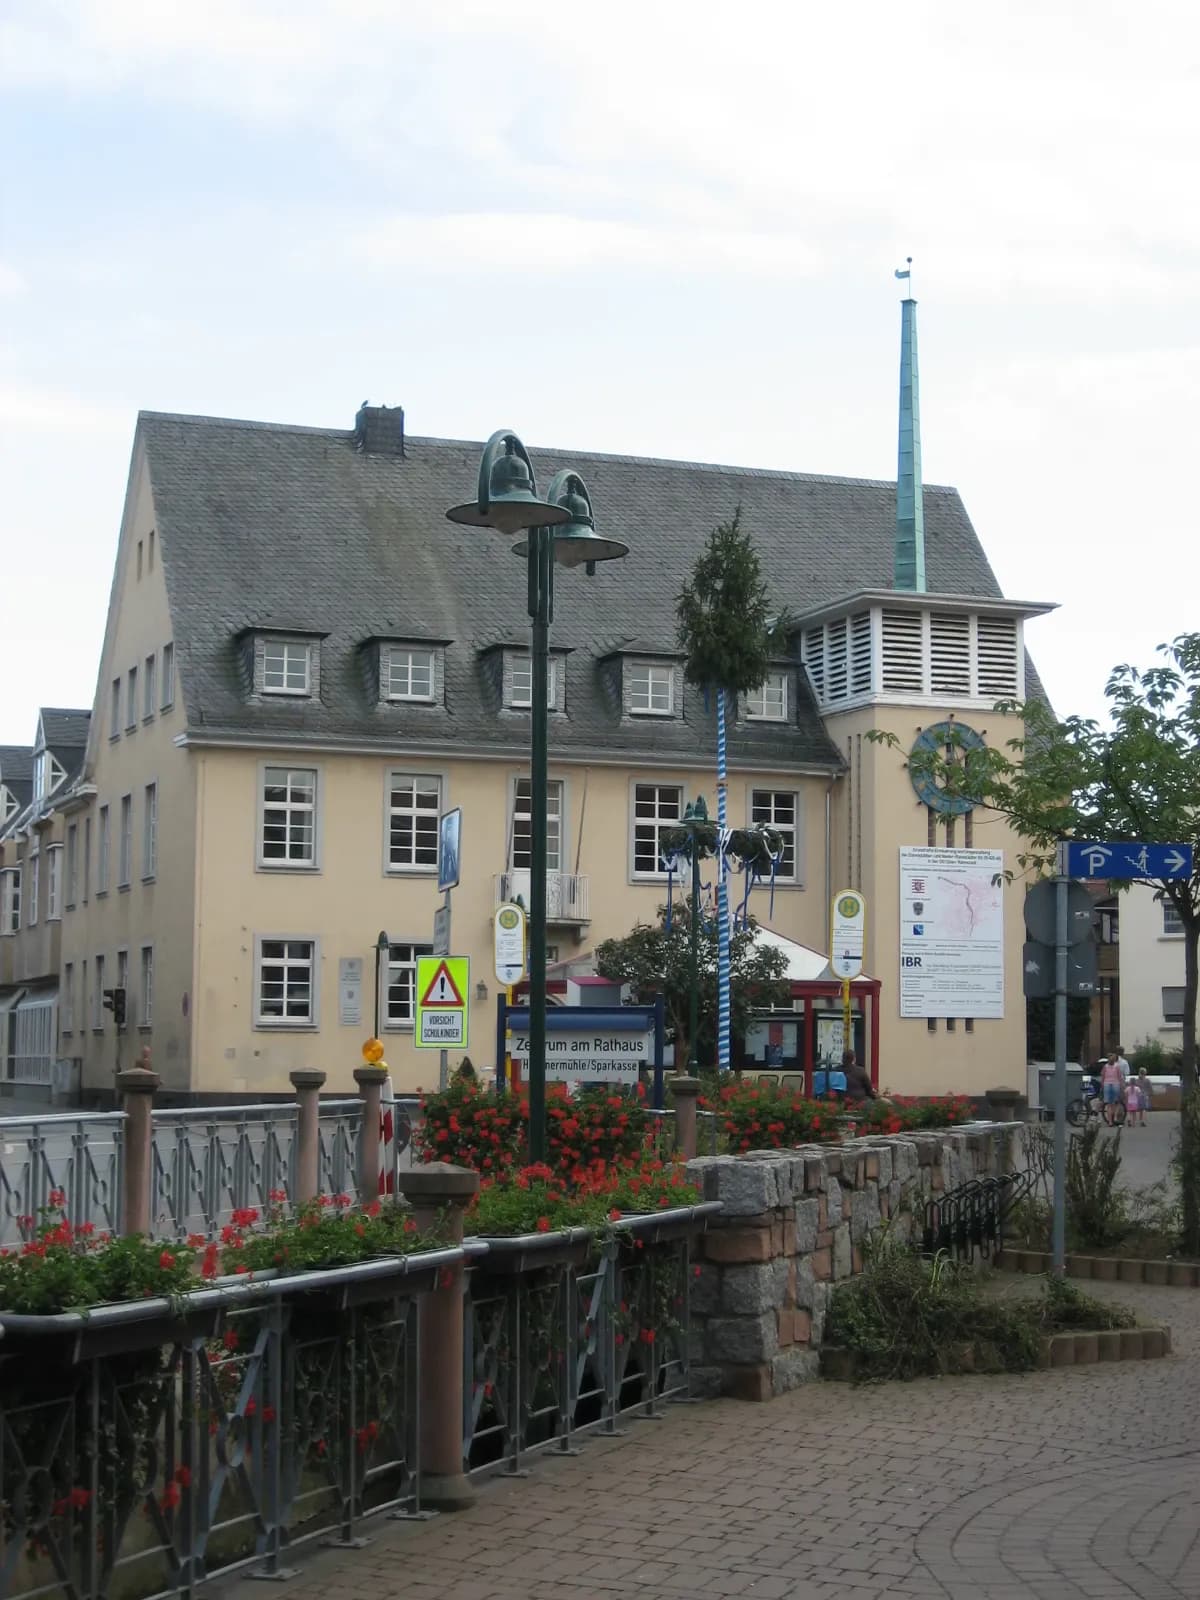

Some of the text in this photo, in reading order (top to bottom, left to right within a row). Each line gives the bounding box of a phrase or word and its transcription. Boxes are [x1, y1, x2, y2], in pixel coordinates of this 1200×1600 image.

[1089, 853, 1105, 875] P
[901, 956, 922, 968] IBR
[429, 1015, 455, 1025] VORSICHT
[424, 1028, 460, 1038] SCHULKINDER
[516, 1038, 643, 1051] Zerum am Rathaus
